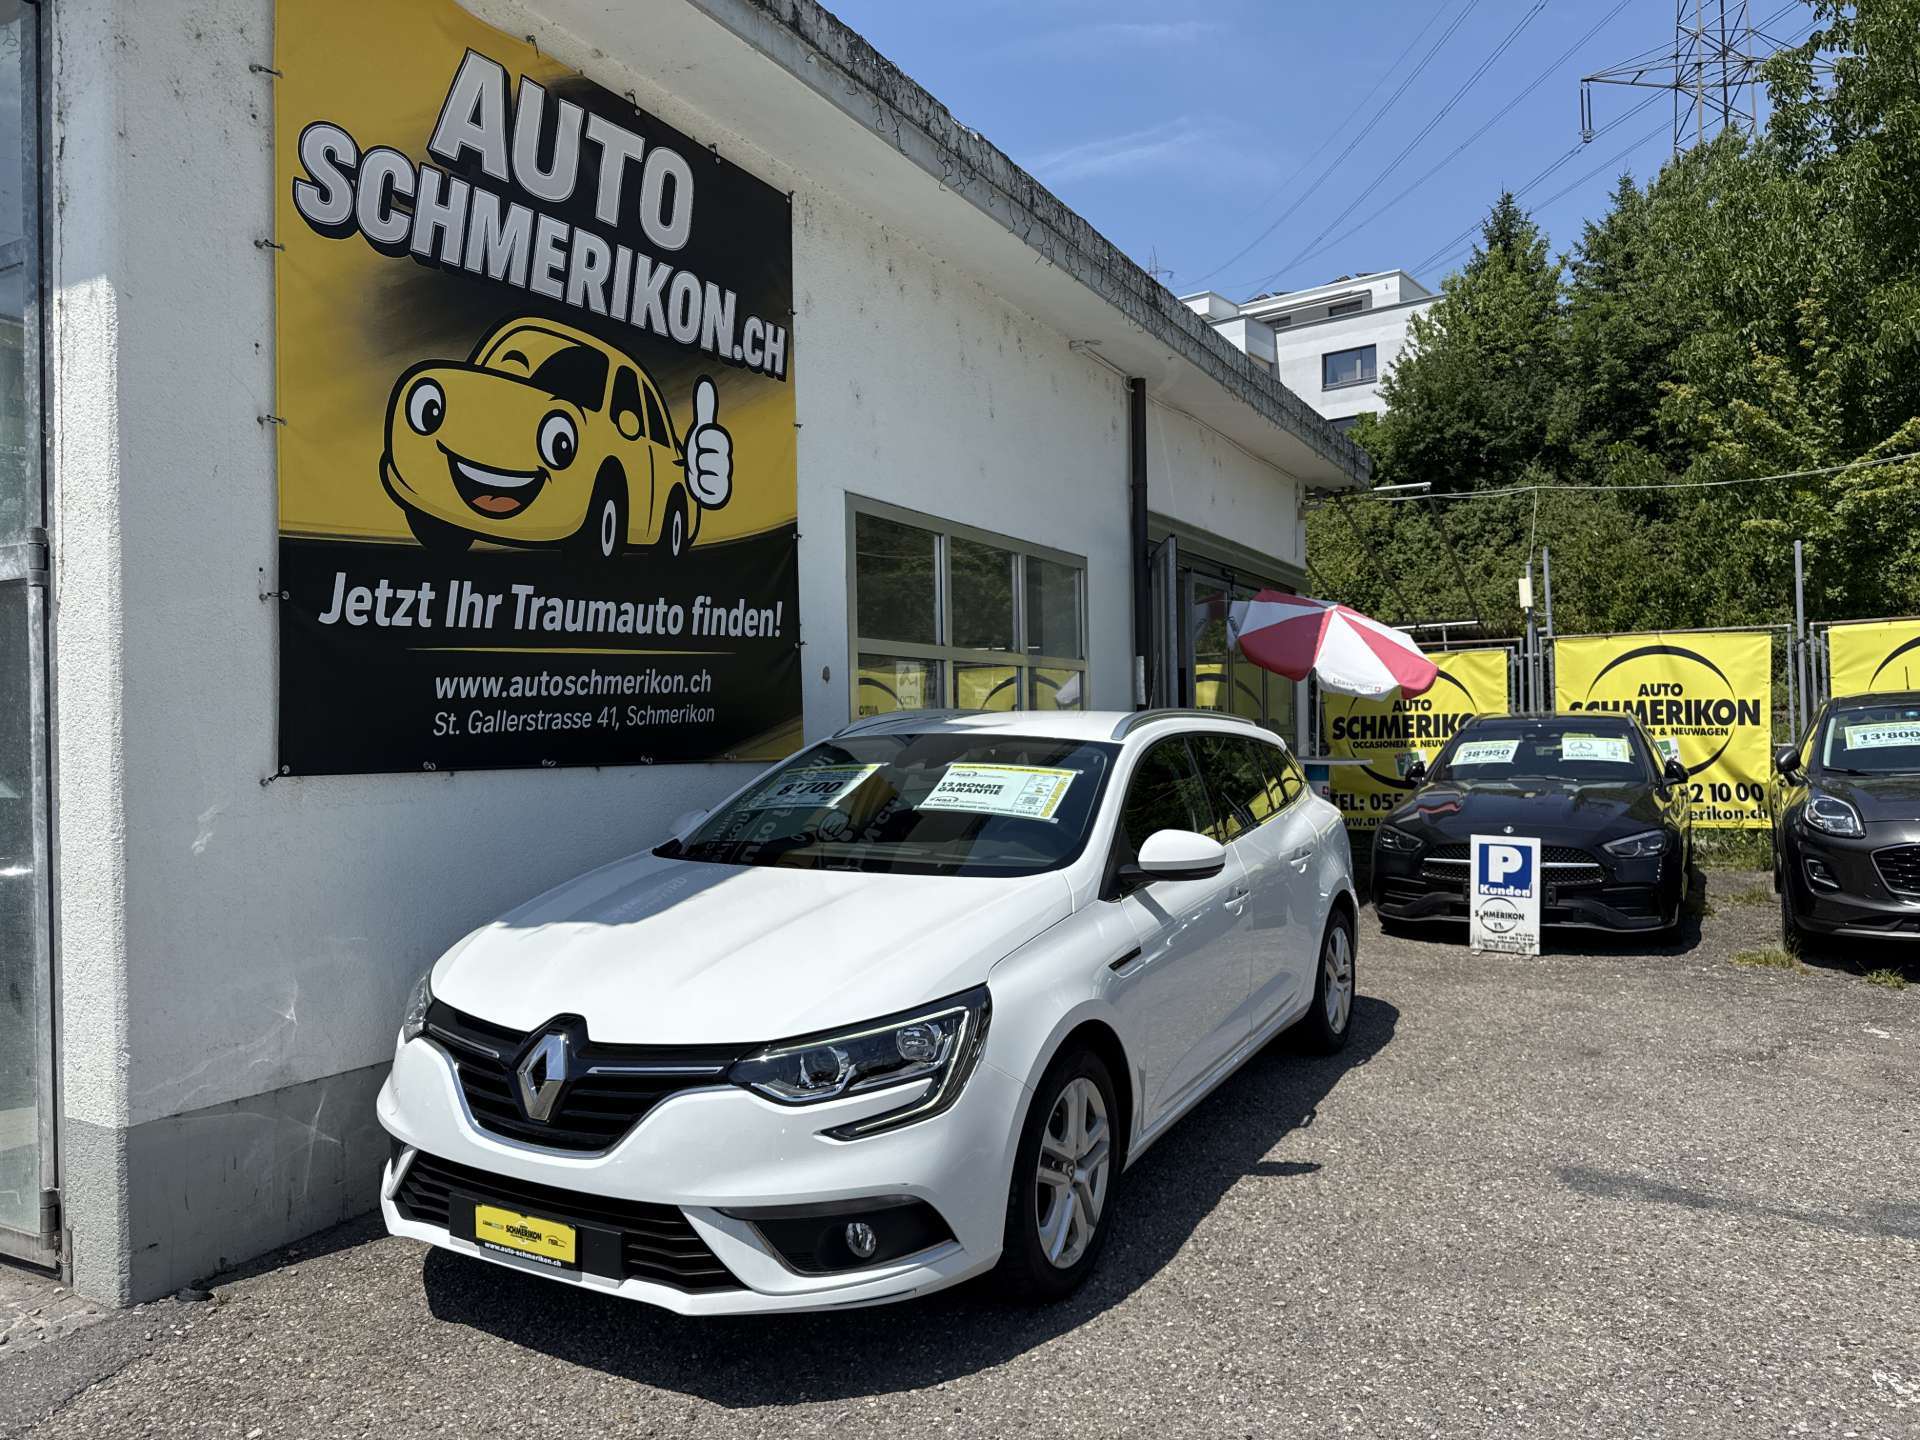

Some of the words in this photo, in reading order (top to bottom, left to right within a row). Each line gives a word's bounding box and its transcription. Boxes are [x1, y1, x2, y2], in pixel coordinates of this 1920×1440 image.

[428, 49, 696, 253] AUTO
[293, 121, 788, 380] SCHMERIKON.CH
[318, 571, 436, 628] Jetzt
[445, 580, 502, 630] Ihr
[511, 584, 684, 636] Traumauto
[691, 597, 784, 638] finden!
[434, 668, 712, 700] www.autoschmerikon.ch
[1638, 683, 1683, 697] AUTO
[1392, 699, 1432, 713] AUTO
[433, 711, 460, 736] St.
[467, 708, 592, 735] Gallerstrasse
[597, 705, 620, 731] 41,
[626, 703, 715, 727] Schmerikon
[1659, 727, 1667, 736] &
[1671, 727, 1729, 736] NEUWAGEN
[1860, 730, 1920, 741] 13'800
[1352, 740, 1407, 749] OCCASIONEN
[1409, 740, 1417, 748] &
[777, 780, 844, 796] 8'700
[937, 786, 1002, 796] GARANTIE
[955, 781, 1005, 790] MONATE
[1708, 782, 1732, 803] 10
[1735, 782, 1765, 802] 00
[1330, 793, 1365, 811] TEL:
[1488, 845, 1523, 883] P
[1480, 883, 1531, 897] Kunden
